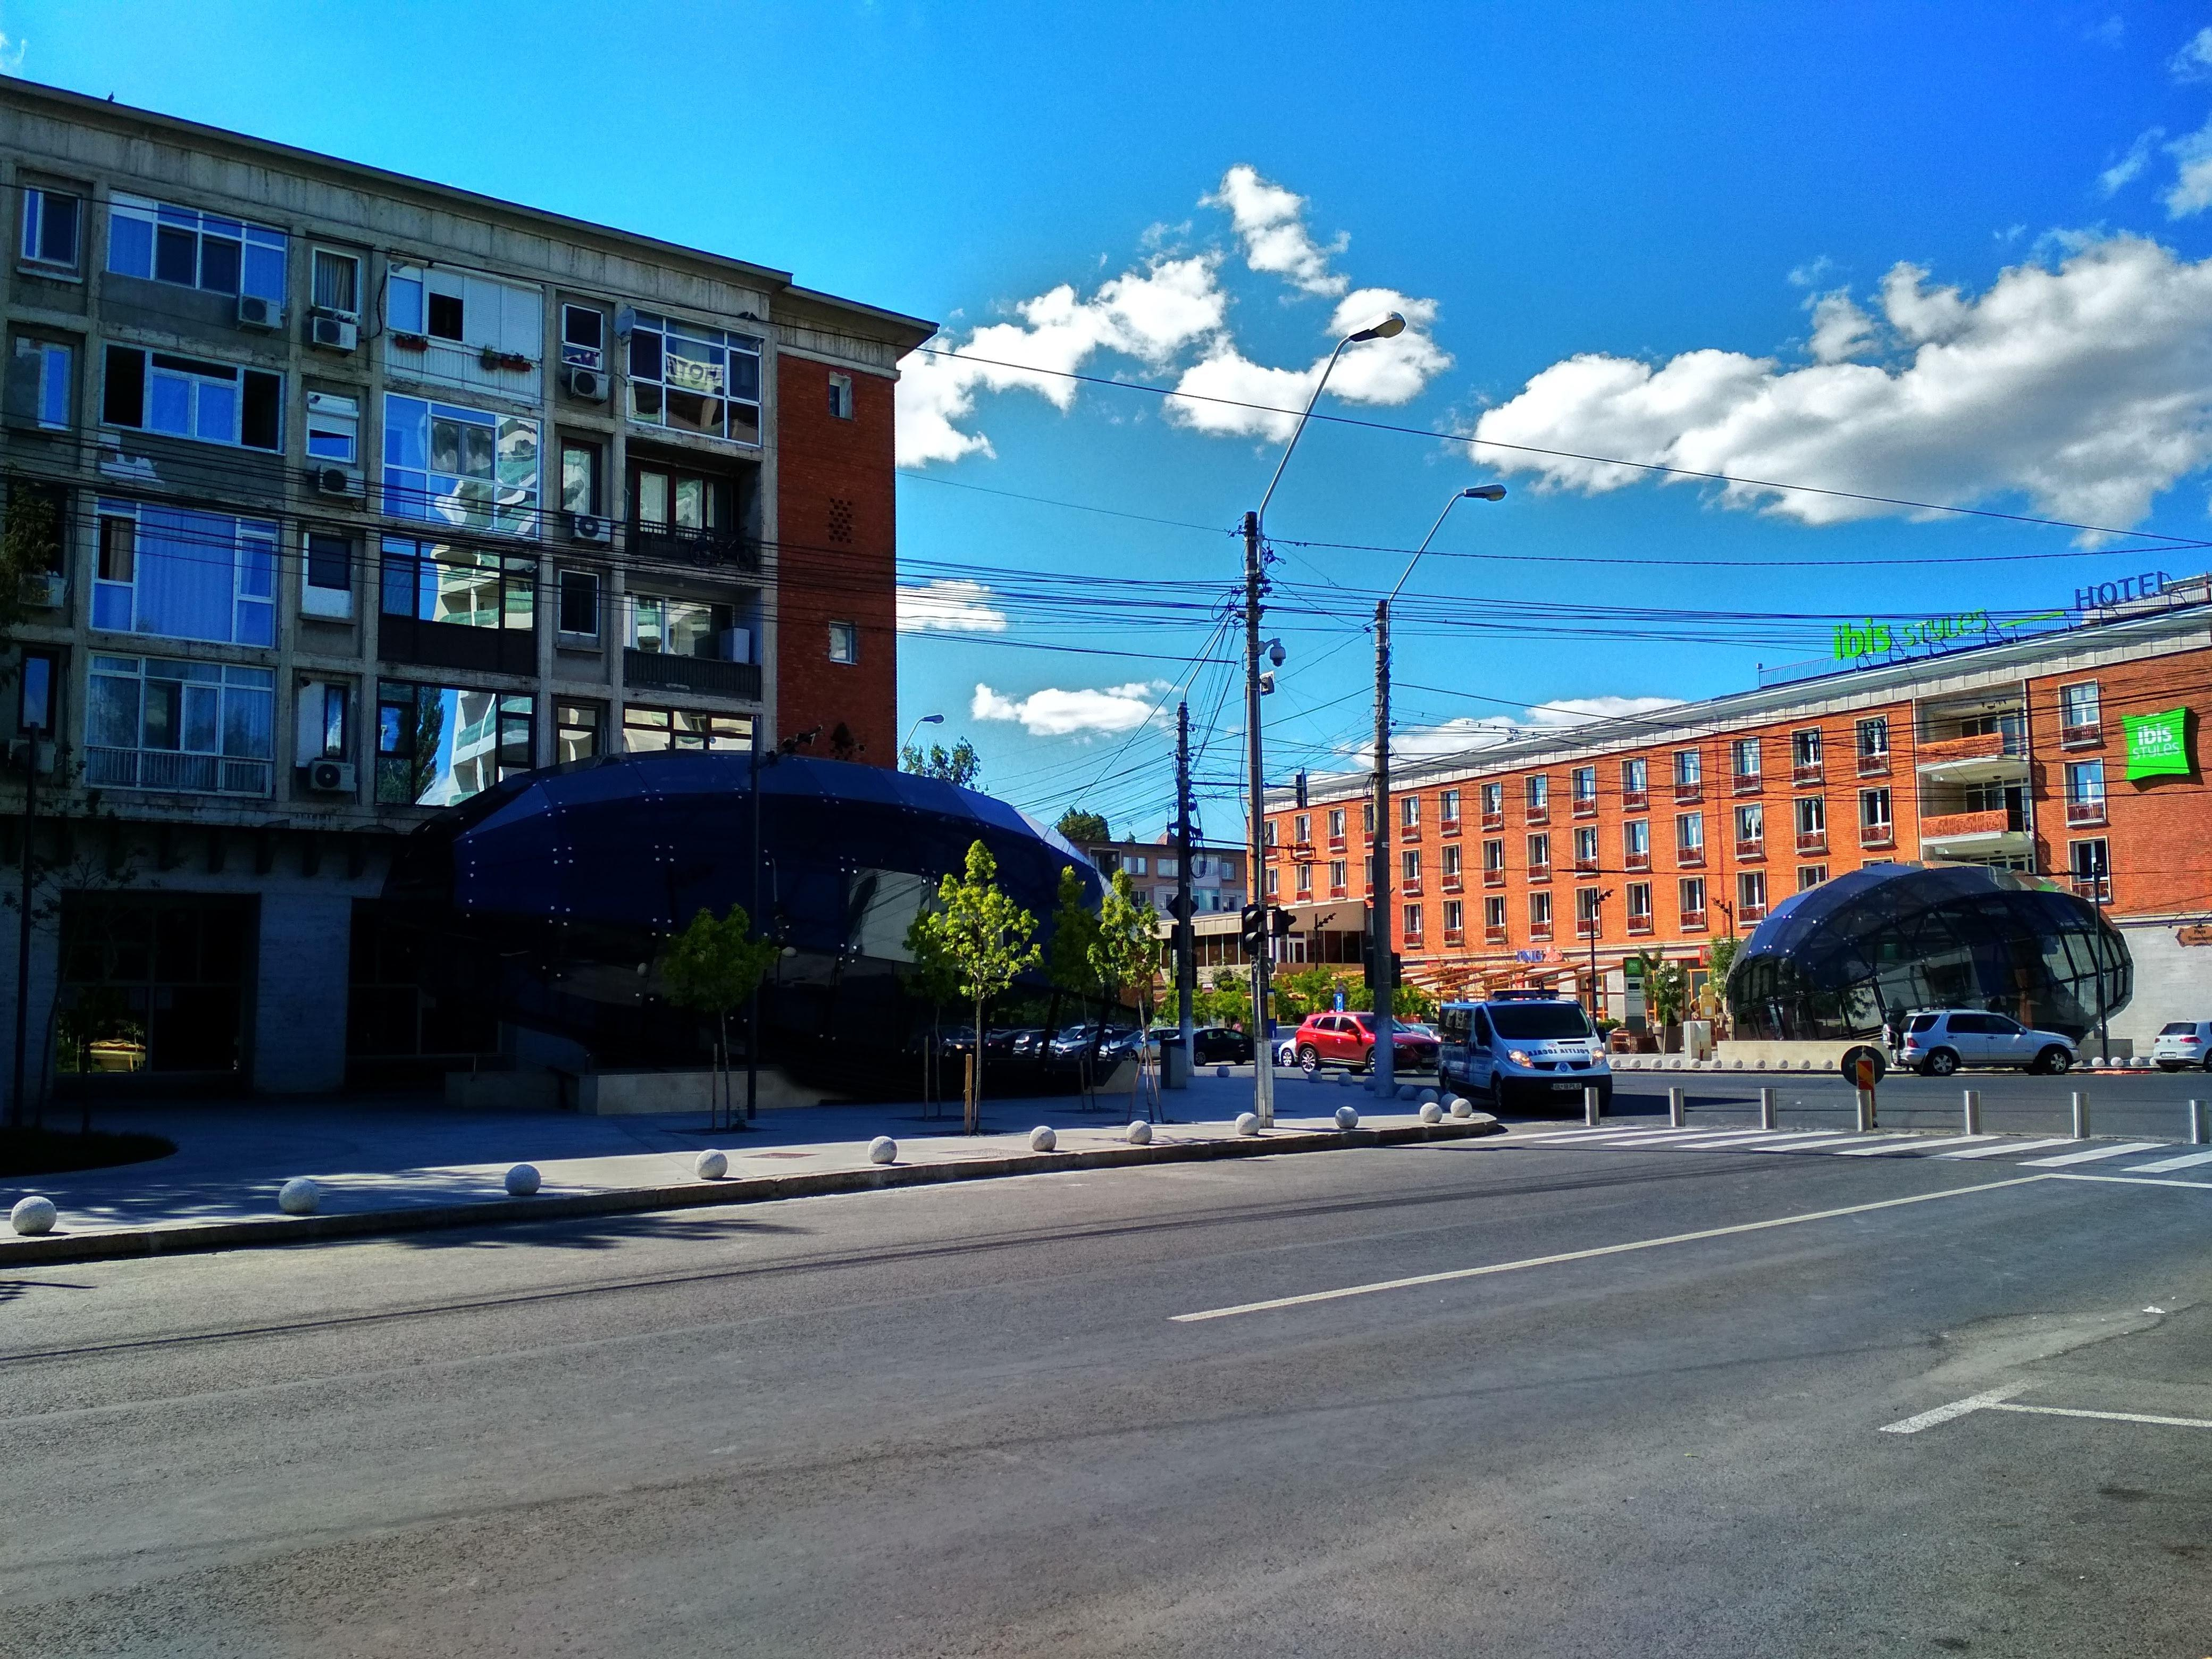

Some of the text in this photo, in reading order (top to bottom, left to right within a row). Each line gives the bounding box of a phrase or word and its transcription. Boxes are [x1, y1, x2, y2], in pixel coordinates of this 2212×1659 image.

[2075, 571, 2173, 611] HOTEL
[1833, 617, 1892, 660] ibis
[2138, 723, 2172, 745] ibis
[1516, 950, 1543, 962] ING
